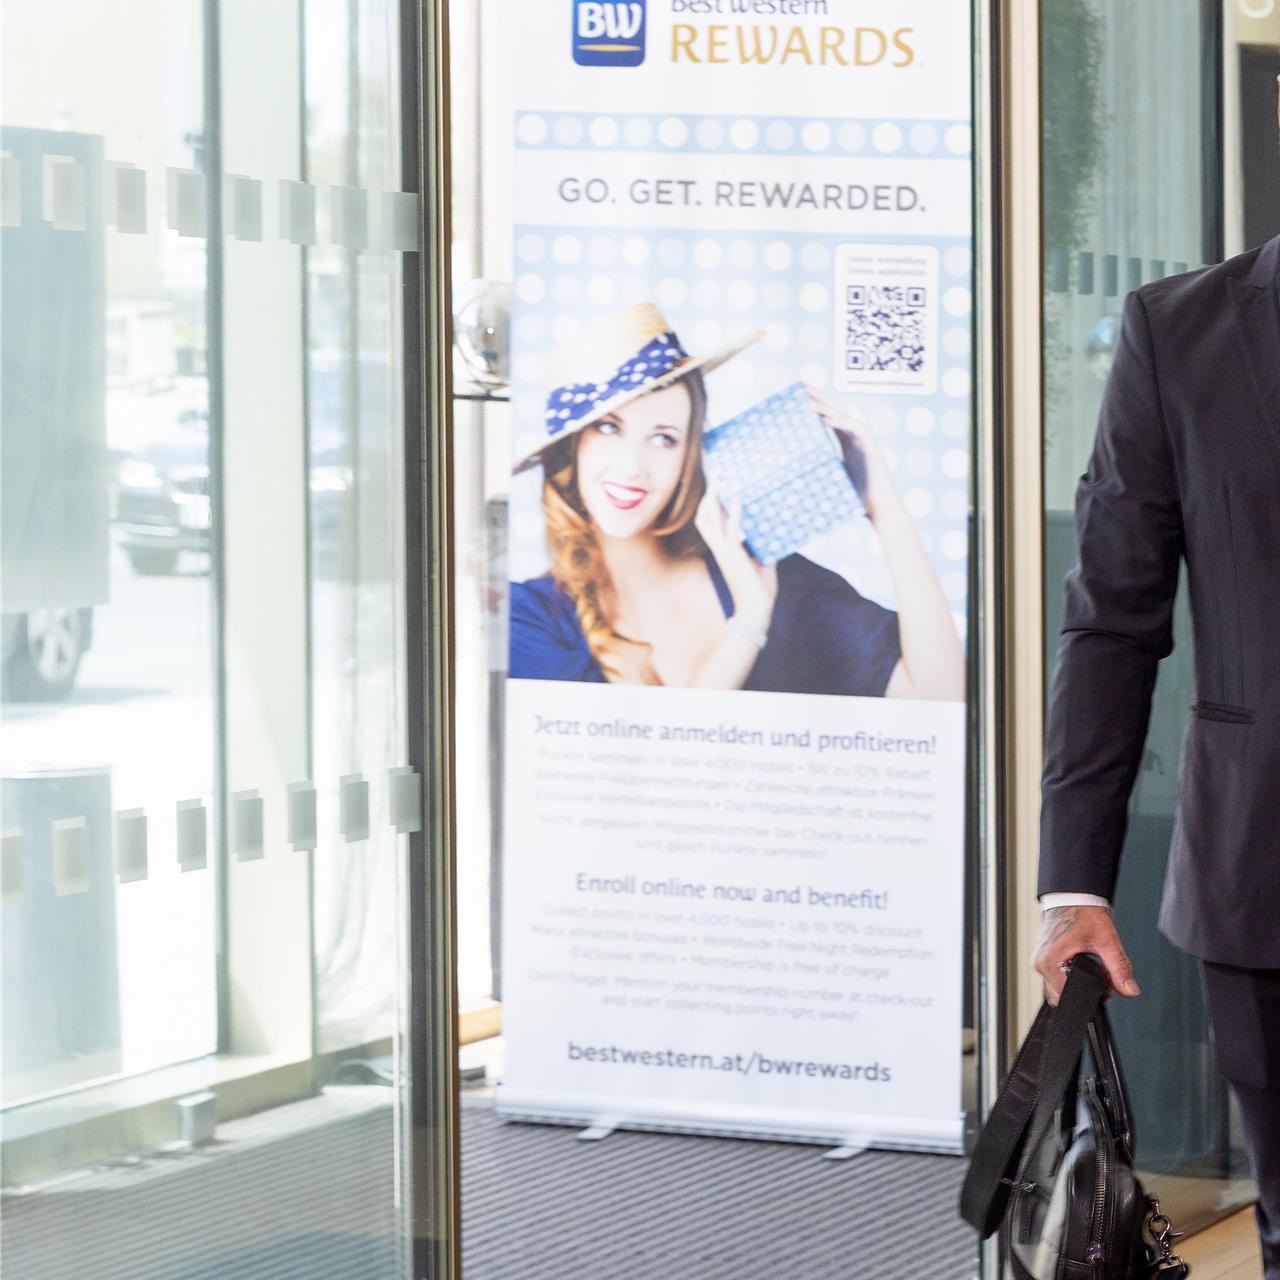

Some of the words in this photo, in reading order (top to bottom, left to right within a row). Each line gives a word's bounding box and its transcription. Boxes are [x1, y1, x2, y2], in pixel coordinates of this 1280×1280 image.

[577, 2, 642, 39] BW
[670, 23, 915, 68] REWARDS
[558, 178, 617, 204] GO.
[630, 179, 701, 206] GET.
[715, 181, 926, 212] REWARDED.
[534, 714, 581, 736] Jetzt
[587, 718, 653, 740] online
[659, 724, 763, 745] anmelden
[770, 728, 811, 748] und
[818, 730, 937, 756] profitieren!
[577, 872, 636, 894] Enroll
[642, 876, 707, 899] online
[713, 884, 757, 902] now
[762, 886, 801, 905] and
[808, 886, 888, 910] benefit!
[568, 1041, 892, 1083] bestwestern.at/bwrewards
